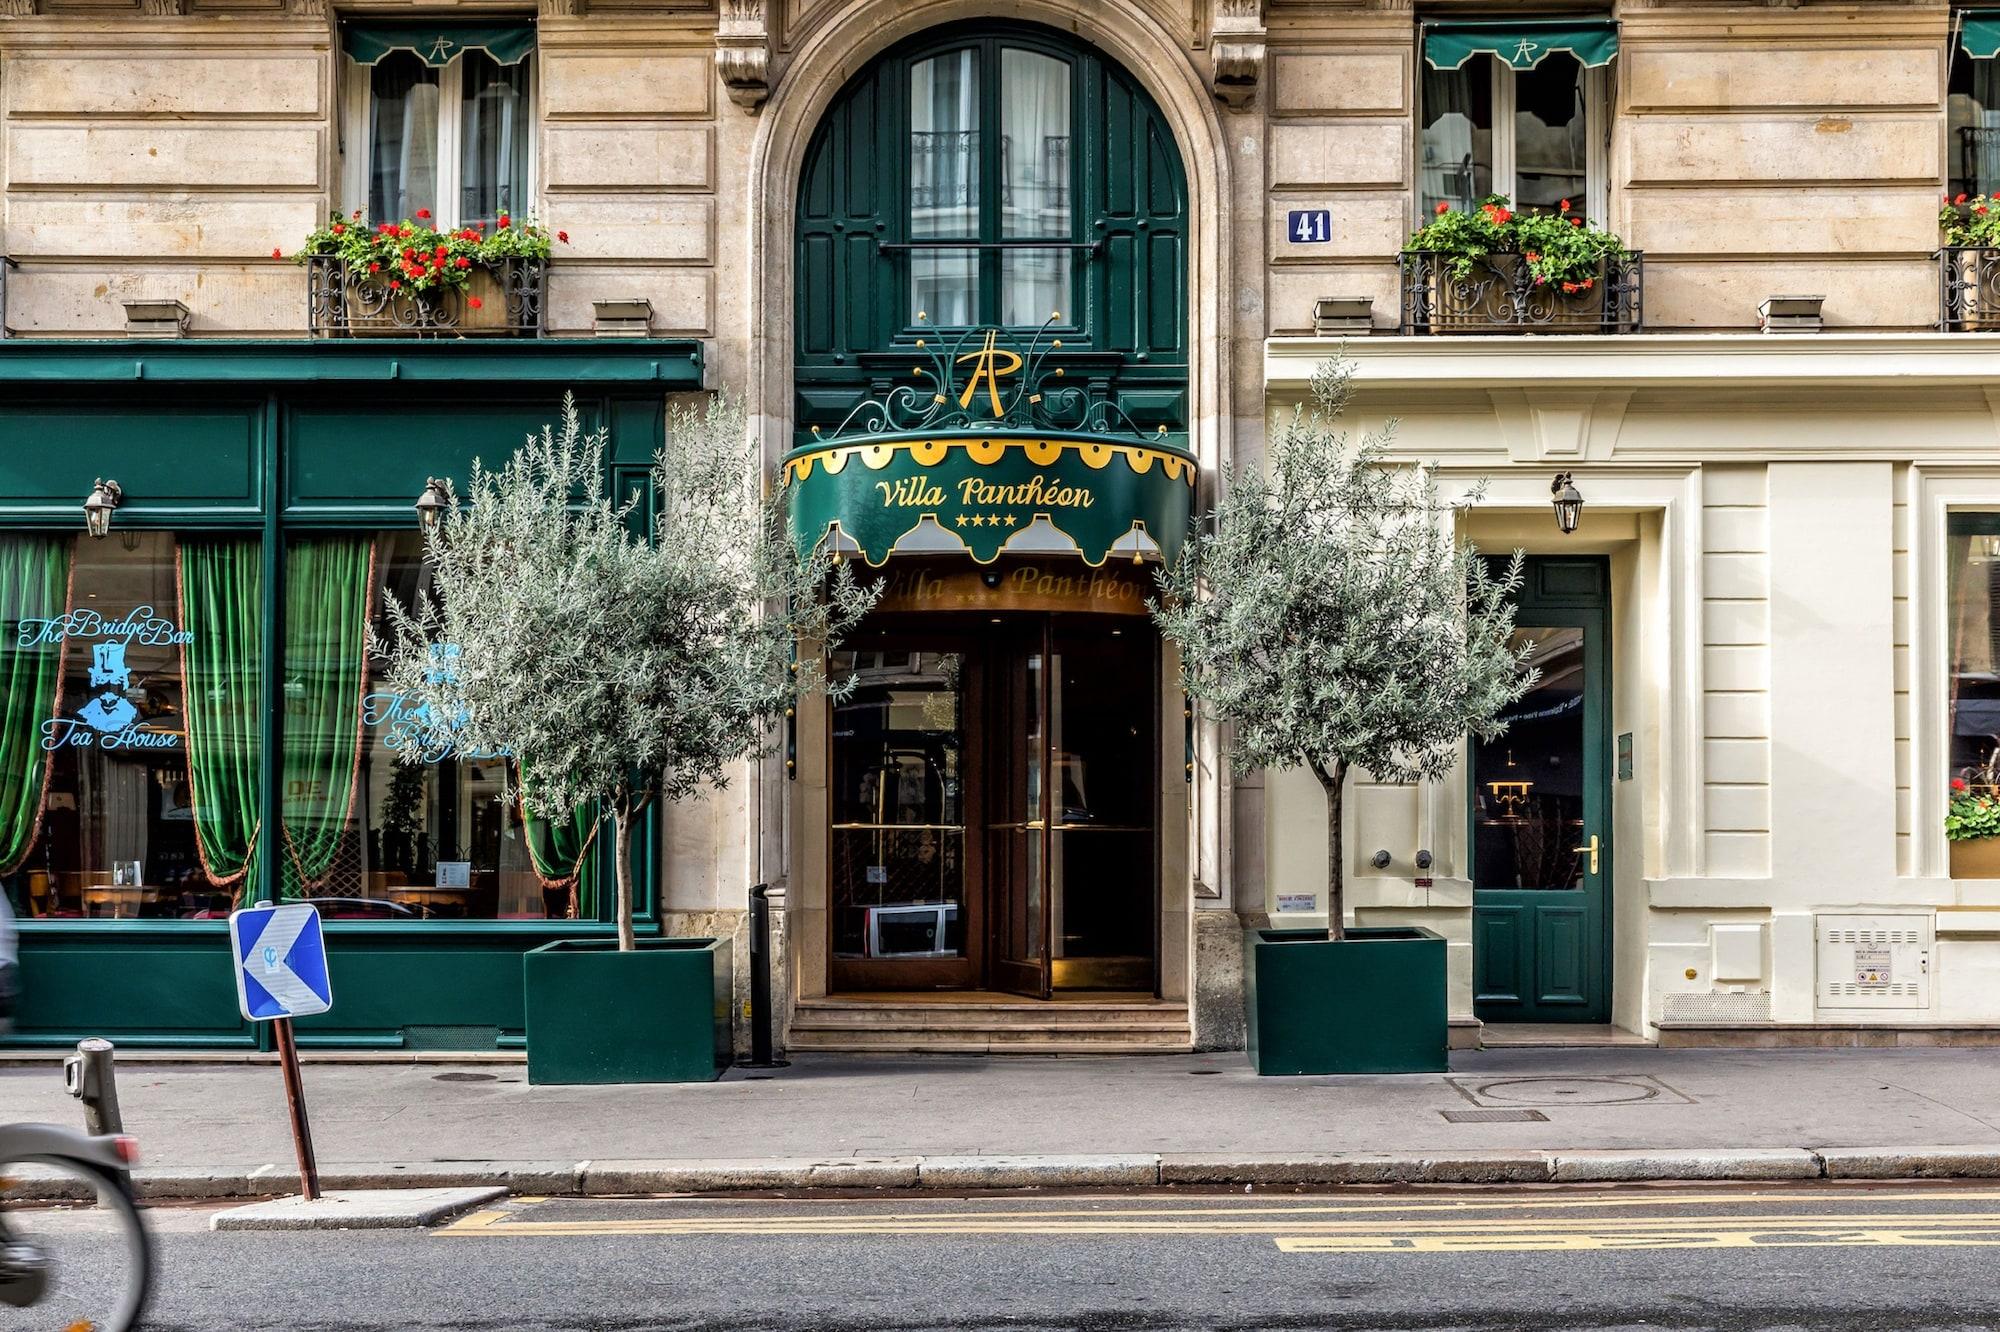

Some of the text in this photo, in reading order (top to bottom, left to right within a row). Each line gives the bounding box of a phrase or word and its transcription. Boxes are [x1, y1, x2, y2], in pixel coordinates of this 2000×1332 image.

[1296, 213, 1325, 241] 41
[875, 474, 1095, 508] Villa Panthéon
[18, 605, 195, 650] The Bridge Bar
[363, 688, 421, 726] The
[41, 719, 178, 750] Tea House
